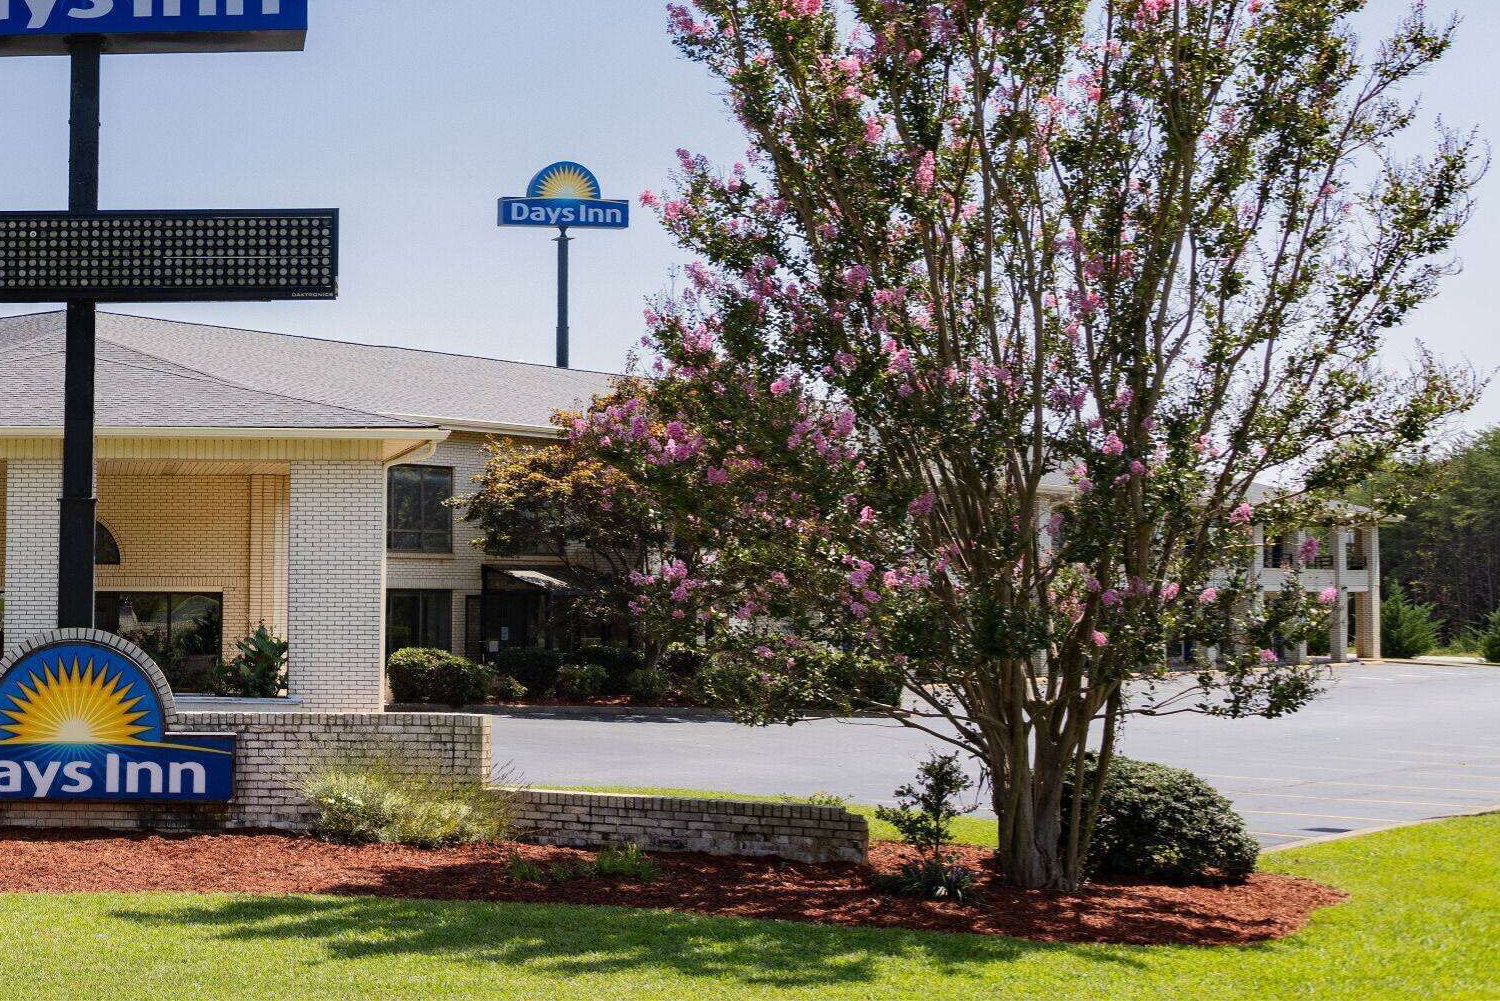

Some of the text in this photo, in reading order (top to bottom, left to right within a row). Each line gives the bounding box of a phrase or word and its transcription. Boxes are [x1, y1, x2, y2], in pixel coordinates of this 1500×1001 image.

[511, 202, 622, 224] Days Inn
[105, 753, 206, 794] Inn
